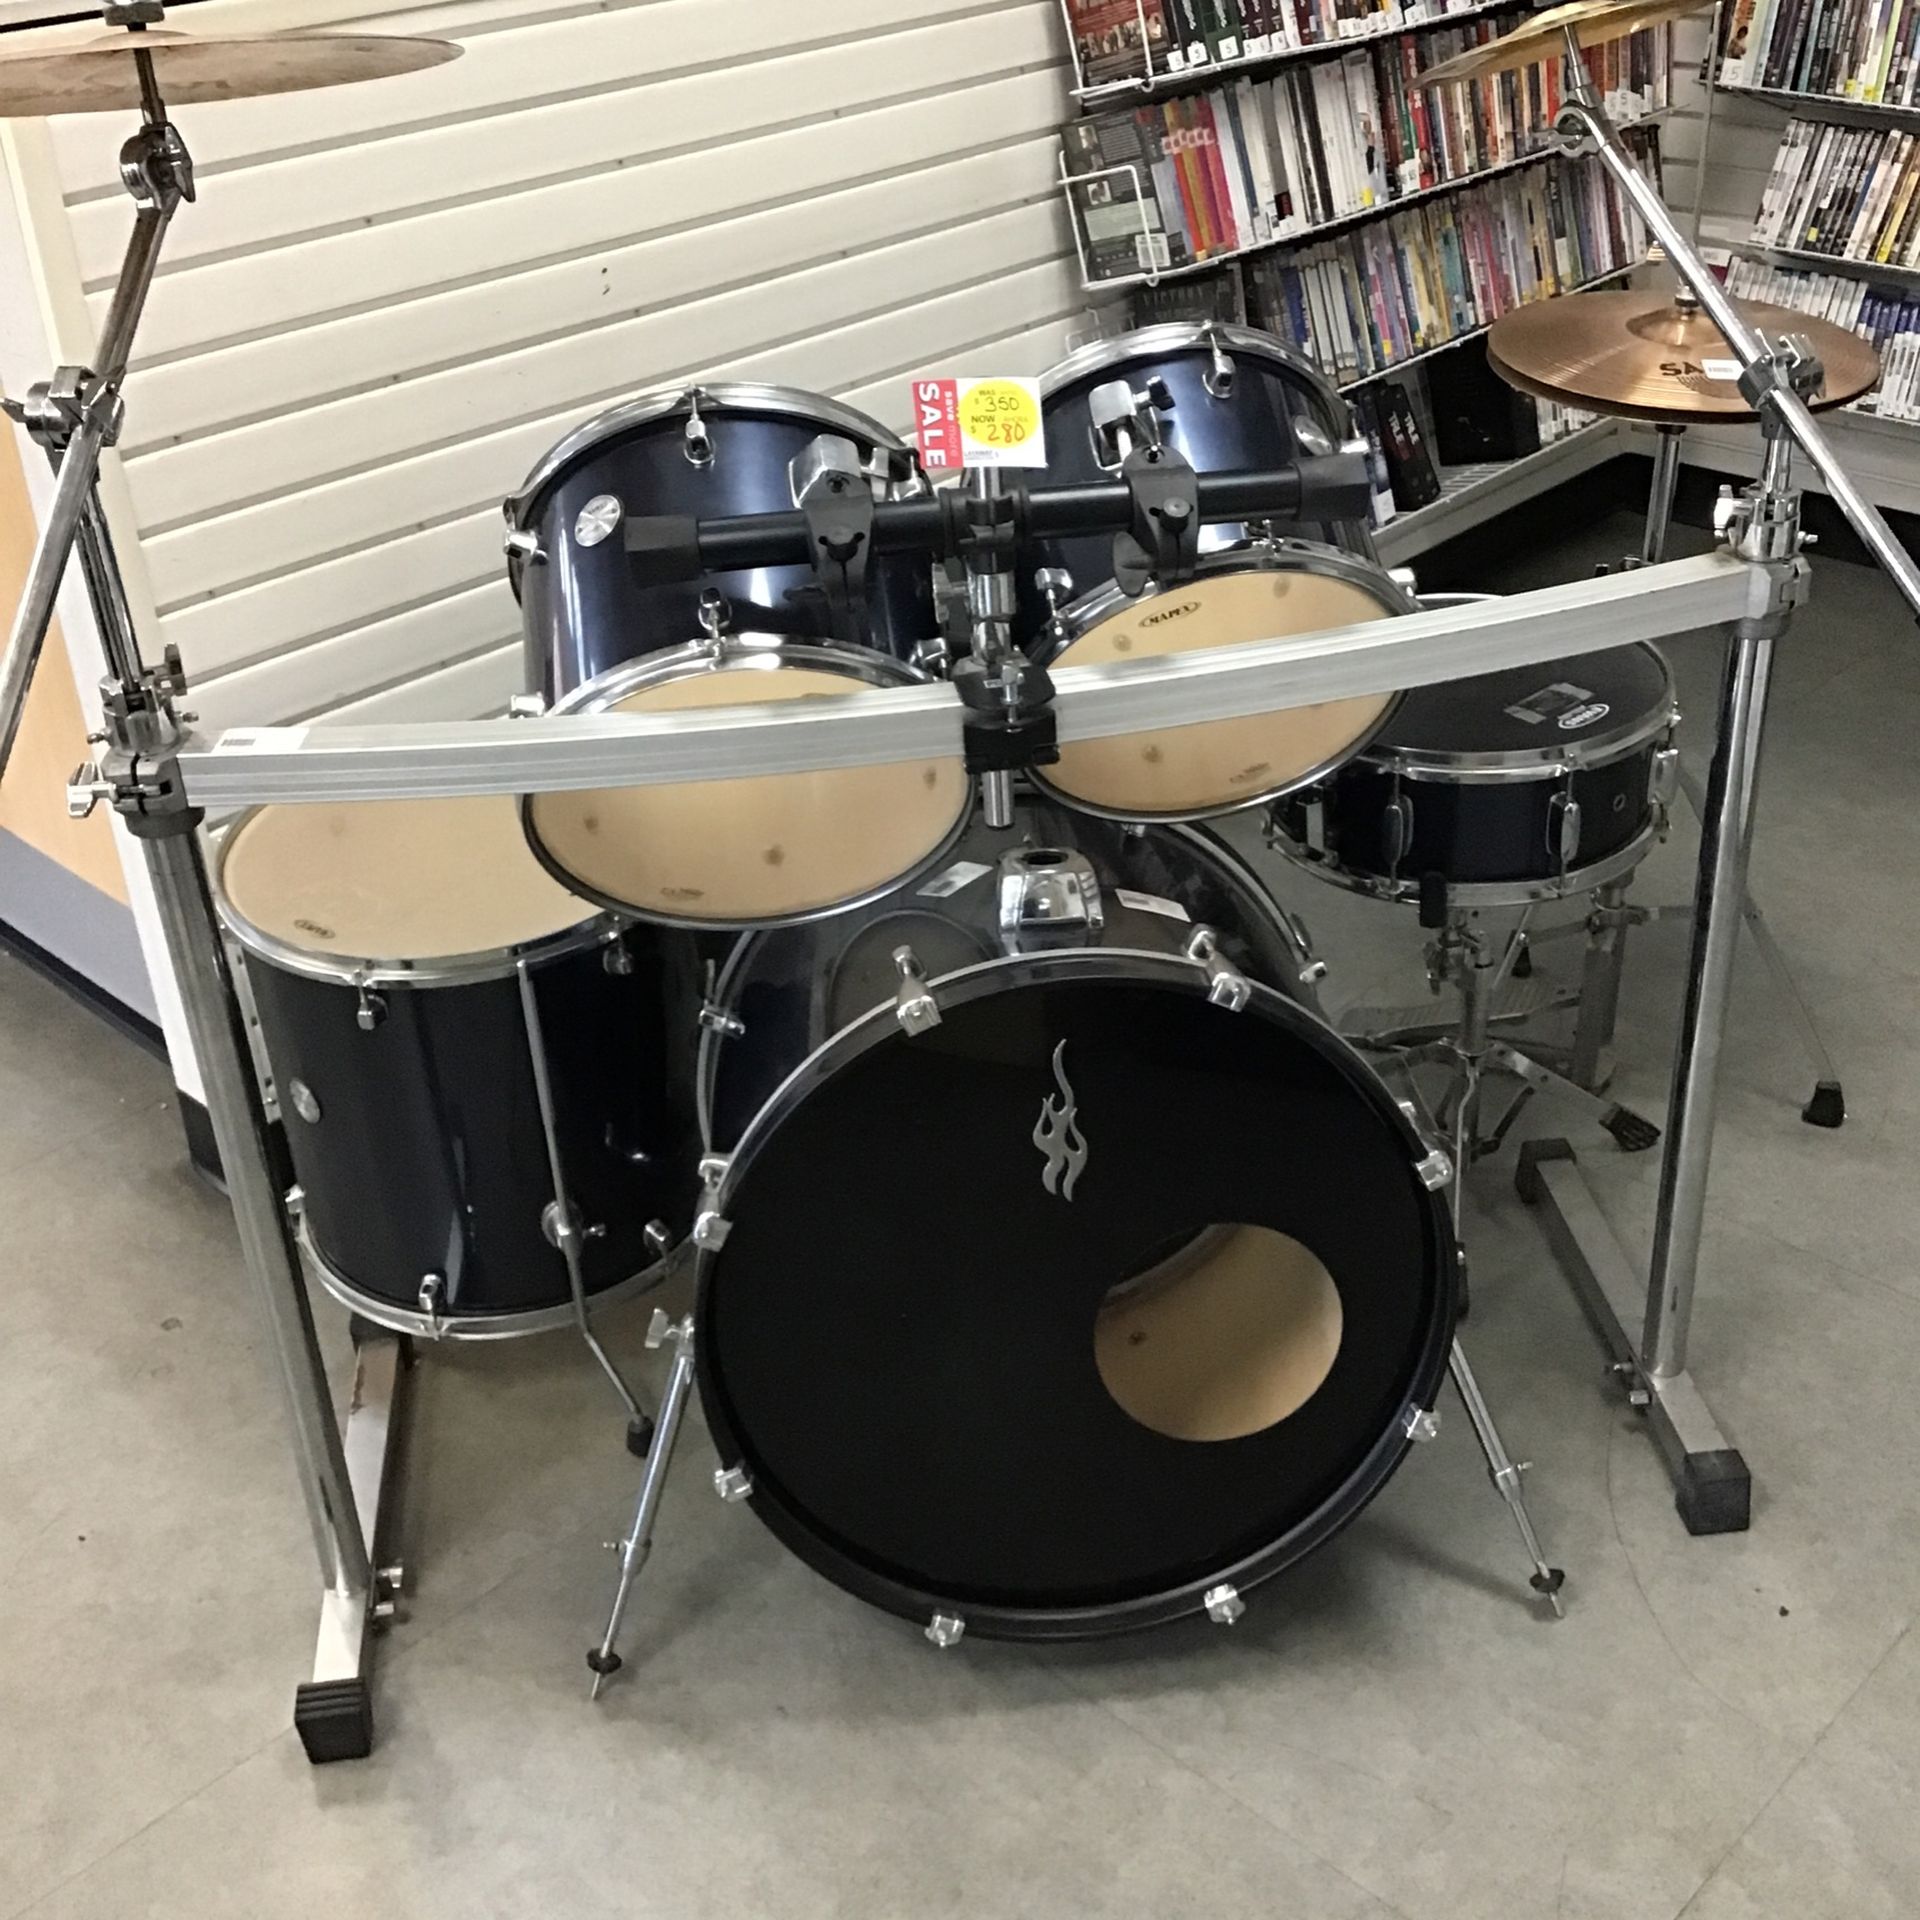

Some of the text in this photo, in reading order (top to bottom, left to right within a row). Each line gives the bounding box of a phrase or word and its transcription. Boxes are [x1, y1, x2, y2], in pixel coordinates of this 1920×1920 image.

[1660, 361, 1703, 377] SA
[984, 396, 1019, 412] 350
[918, 382, 947, 467] SALE
[944, 391, 959, 457] save more
[971, 415, 995, 423] NOW
[987, 421, 1025, 443] 280
